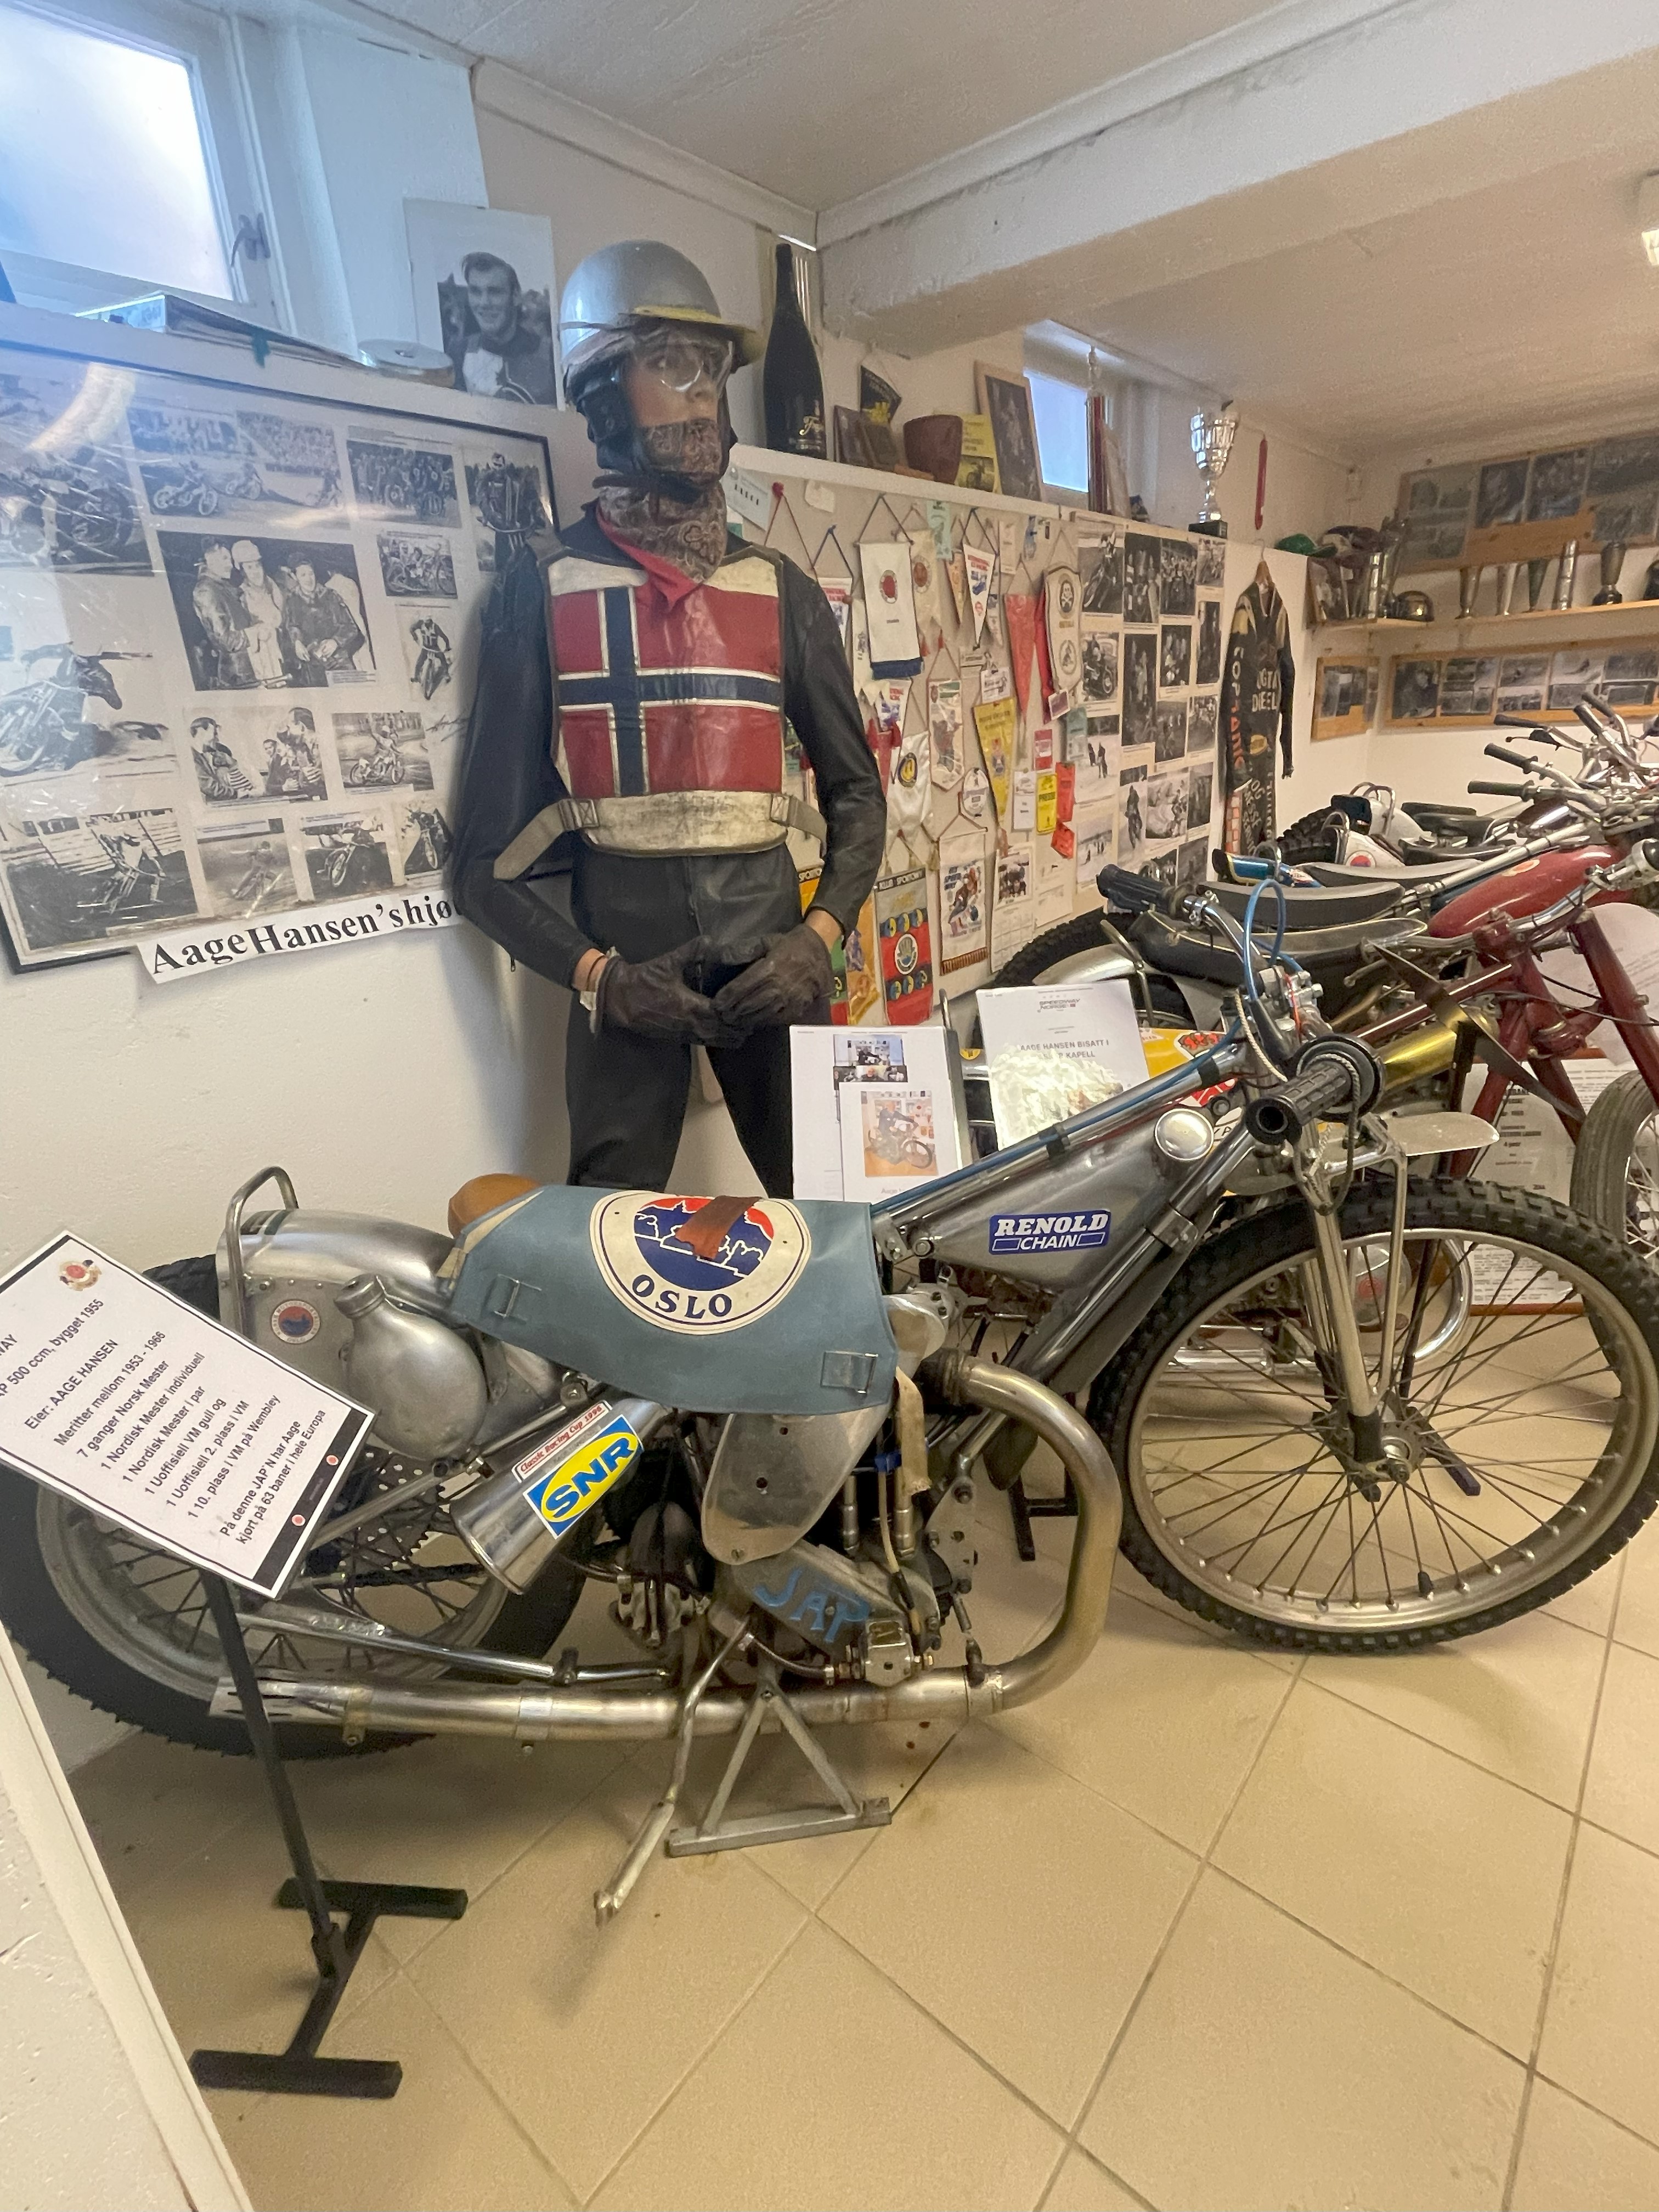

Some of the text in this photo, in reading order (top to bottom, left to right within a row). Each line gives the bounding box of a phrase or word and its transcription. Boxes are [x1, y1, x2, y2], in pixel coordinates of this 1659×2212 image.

[1043, 1042, 1075, 1050] HANSEN
[1077, 1040, 1104, 1048] BISATT
[1065, 1051, 1096, 1059] KAPELL
[994, 1214, 1109, 1237] RENOLD
[1020, 1234, 1077, 1250] CHAIN
[632, 1274, 732, 1319] OSLO
[7, 1366, 30, 1385] 500
[29, 1348, 56, 1367] ccm,
[49, 1317, 84, 1346] bygget
[81, 1299, 104, 1318] 1955
[24, 1339, 119, 1429] Eier: AAGE HANSEN
[54, 1407, 94, 1446] Meritter
[92, 1375, 126, 1408] mellom
[122, 1355, 144, 1374] 1953
[144, 1331, 166, 1350] 1966
[77, 1361, 169, 1458] 7 ganger Norsk Mester
[106, 1424, 145, 1463] Nordisk
[139, 1393, 170, 1425] Mester
[164, 1352, 205, 1395] individuell
[128, 1436, 165, 1475] Nordisk
[160, 1406, 189, 1437] Mester
[190, 1386, 205, 1403] par
[150, 1443, 190, 1487] Uoffisiell
[183, 1427, 202, 1443] VM
[198, 1409, 215, 1430] gull
[212, 1398, 227, 1411] og
[171, 1454, 210, 1499] Uoffisiell
[204, 1447, 217, 1455] 2.
[213, 1421, 235, 1447] plass
[233, 1400, 250, 1415] VM
[194, 1496, 211, 1509] 10.
[207, 1467, 229, 1496] plass
[227, 1444, 245, 1460] VM
[241, 1432, 253, 1447] på
[247, 1395, 281, 1432] Wembley
[219, 1521, 236, 1537] På
[232, 1489, 257, 1521] denne
[270, 1443, 286, 1458] har
[281, 1420, 301, 1444] Aage
[253, 1504, 267, 1521] på
[261, 1491, 274, 1505] 63
[268, 1464, 291, 1492] baner
[289, 1440, 307, 1460] hele
[301, 1409, 326, 1440] Europa
[520, 1451, 544, 1472] Classic
[544, 1429, 571, 1452] Racing
[569, 1421, 583, 1434] Cup
[545, 1437, 635, 1519] SNR
[752, 1567, 871, 1643] JAP
